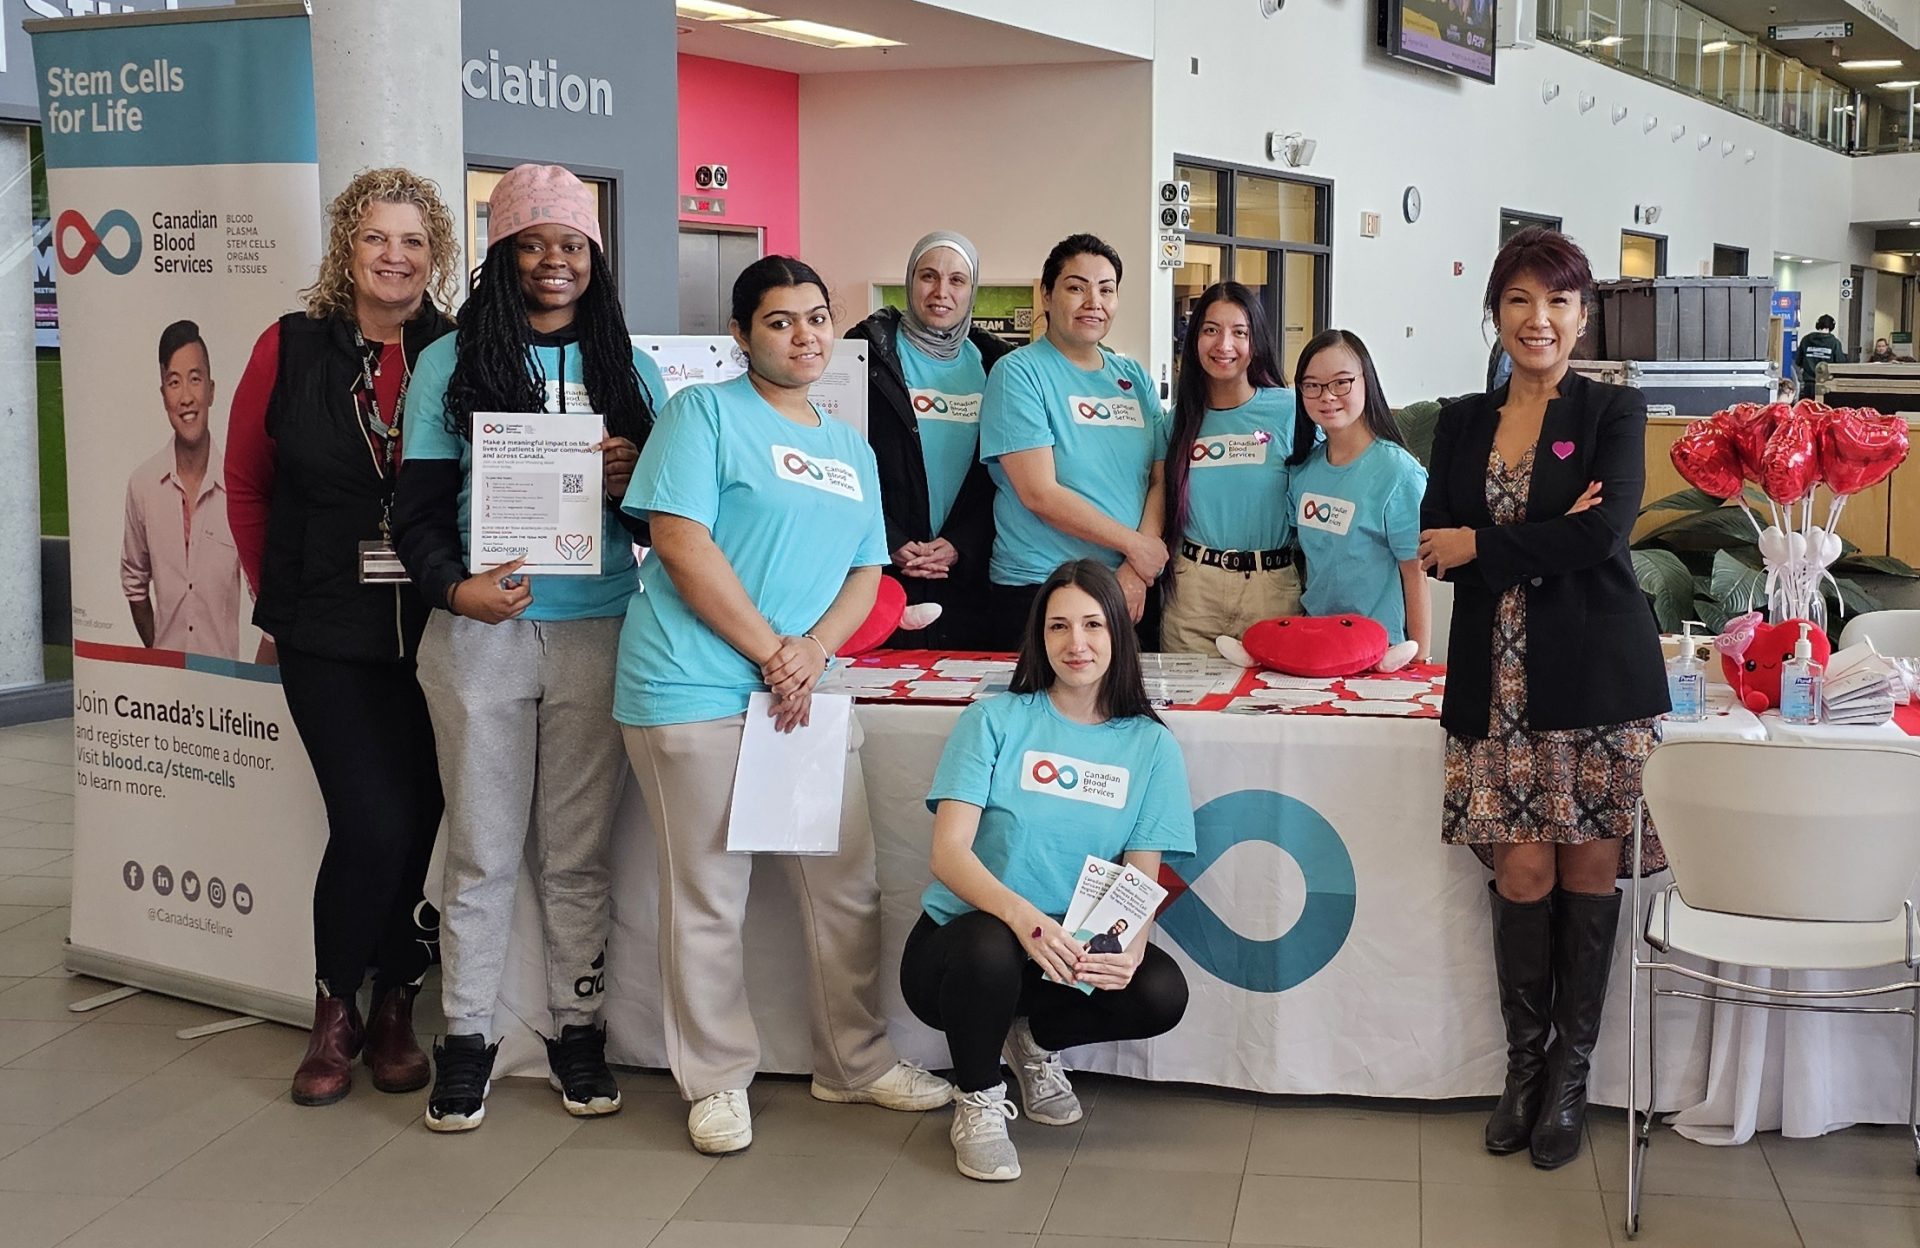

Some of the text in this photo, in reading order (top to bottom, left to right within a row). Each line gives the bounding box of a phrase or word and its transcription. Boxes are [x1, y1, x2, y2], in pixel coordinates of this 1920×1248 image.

[47, 59, 184, 97] Stem Cells
[462, 48, 613, 116] ciation
[49, 98, 143, 134] for Life
[152, 210, 217, 230] Canadian
[226, 214, 254, 224] BLOOD
[226, 227, 259, 236] PLASMA
[153, 233, 195, 252] Blood
[226, 239, 276, 249] STEM CELLS
[154, 255, 213, 274] Services
[226, 252, 259, 262] ORGANS
[227, 264, 268, 274] & TISSUES
[973, 320, 1004, 331] TEAM
[507, 446, 535, 454] patients
[1717, 631, 1746, 648] XOXO
[75, 688, 108, 716] Join
[209, 707, 280, 741] Lifeline
[76, 725, 275, 771] and register to become a donor.
[76, 747, 236, 789] Visit blood.ca/stem-cells
[1084, 771, 1121, 783] Canadian
[77, 772, 167, 799] to learn more.
[1083, 778, 1107, 788] Blood
[1083, 786, 1115, 799] Services
[147, 907, 234, 939] @CanadasLifeline
